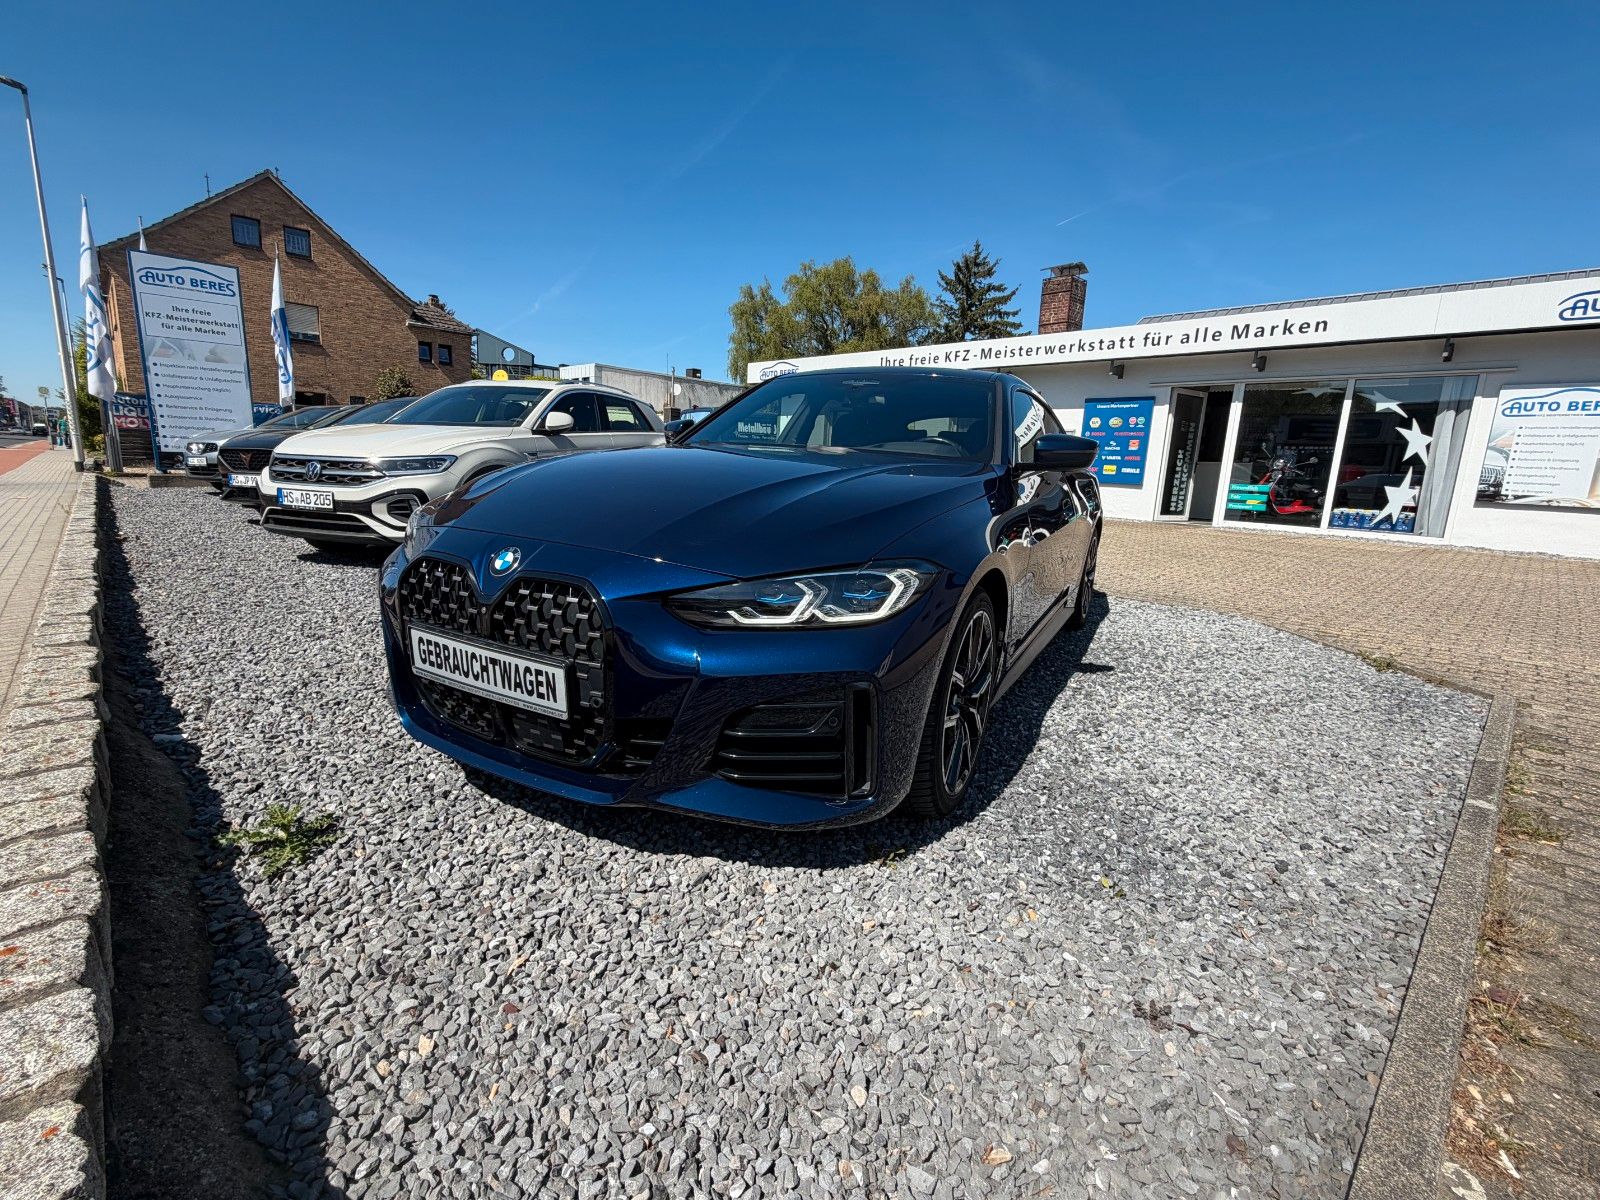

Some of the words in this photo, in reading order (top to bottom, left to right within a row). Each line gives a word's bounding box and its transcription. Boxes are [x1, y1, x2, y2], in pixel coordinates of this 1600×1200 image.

[139, 270, 186, 286] AUTO
[189, 278, 237, 297] BERES
[144, 311, 239, 329] KFZ-Meisterwerkstatt
[171, 305, 190, 315] Ihre
[192, 308, 212, 317] freie
[160, 322, 174, 330] für
[176, 325, 193, 333] alle
[194, 327, 226, 336] Marken
[880, 356, 905, 367] Ihre
[908, 352, 940, 367] freie
[944, 335, 1136, 363] KFZ-Meisterwerkstatt
[1143, 332, 1173, 347] für
[1179, 326, 1223, 345] alle
[1230, 318, 1328, 340] Marken
[760, 369, 779, 380] AUTO
[1502, 402, 1561, 417] AUTO
[1176, 422, 1196, 512] WILLKOMMEN
[1169, 449, 1184, 512] HERZLICH
[283, 490, 295, 504] HS
[300, 492, 312, 505] AB
[313, 493, 332, 506] 205
[417, 636, 558, 704] GEBRAUCHTWAGEN
